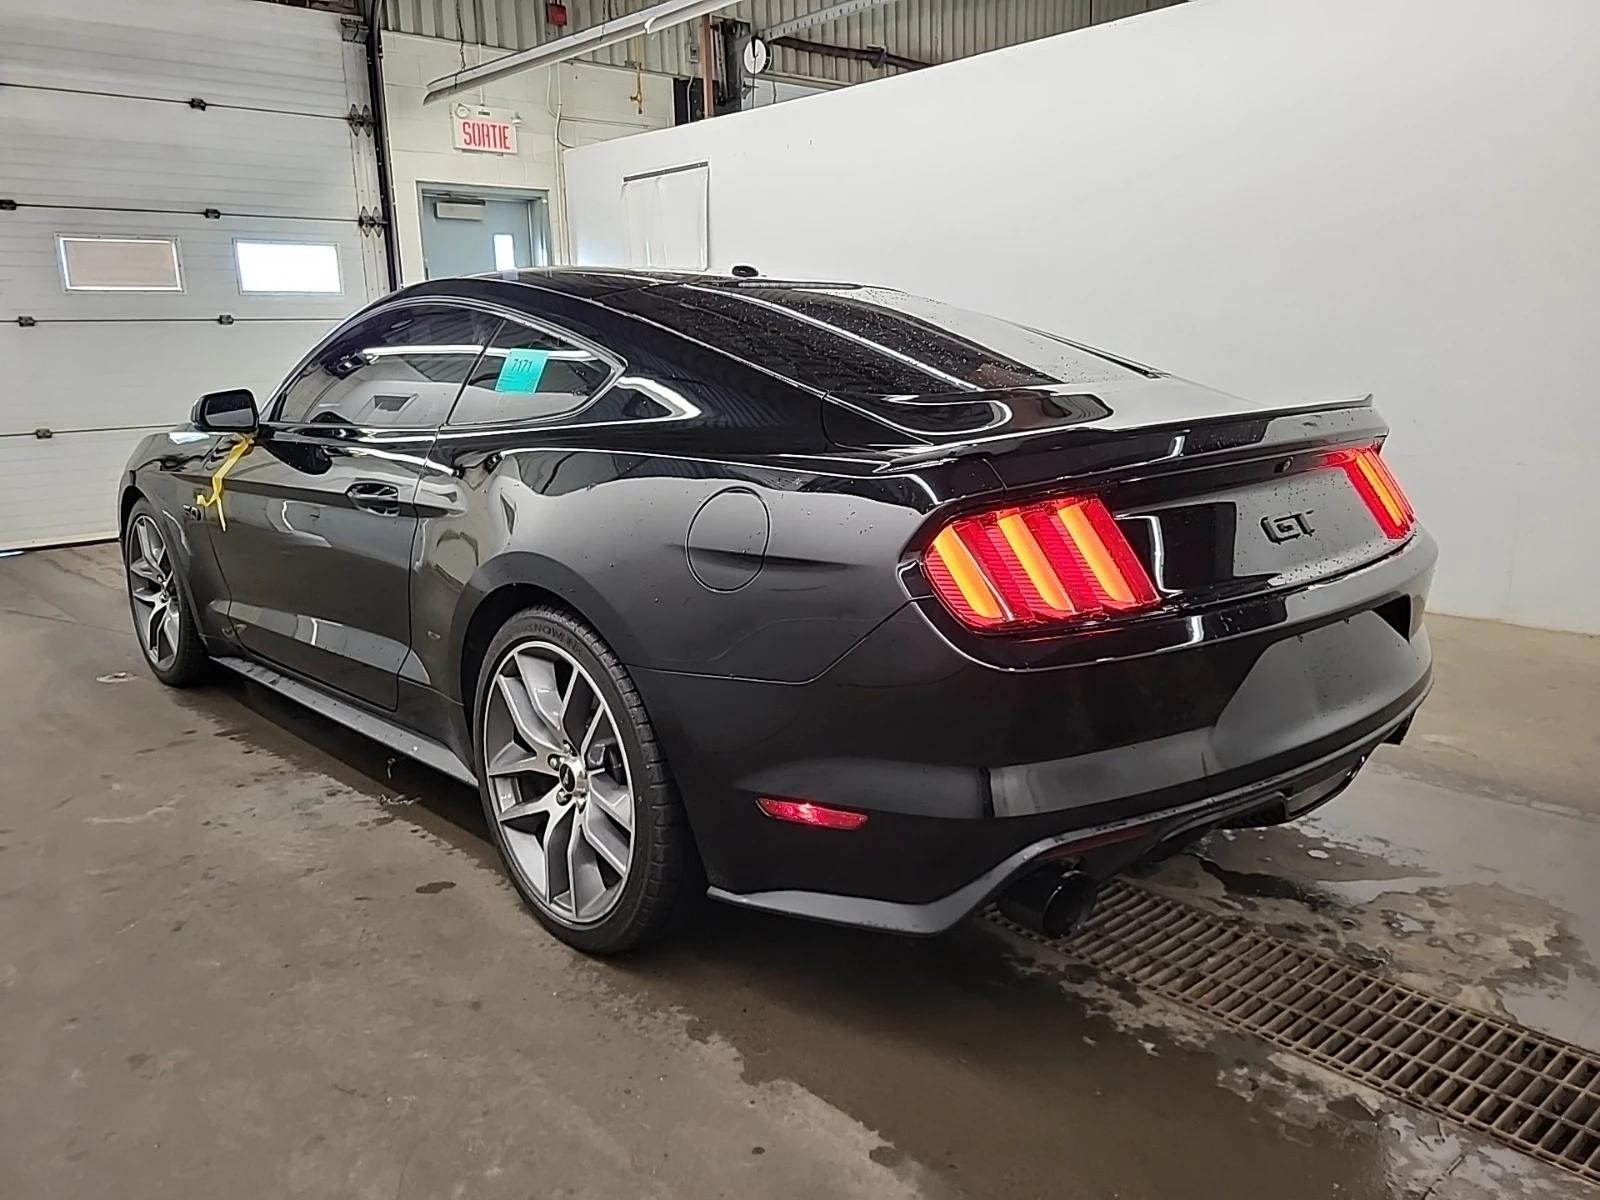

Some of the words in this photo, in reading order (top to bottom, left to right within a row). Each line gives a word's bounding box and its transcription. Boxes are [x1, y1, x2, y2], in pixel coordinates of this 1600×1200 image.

[462, 121, 511, 150] SORTIE
[511, 358, 533, 373] 7171
[1260, 509, 1316, 546] GT
